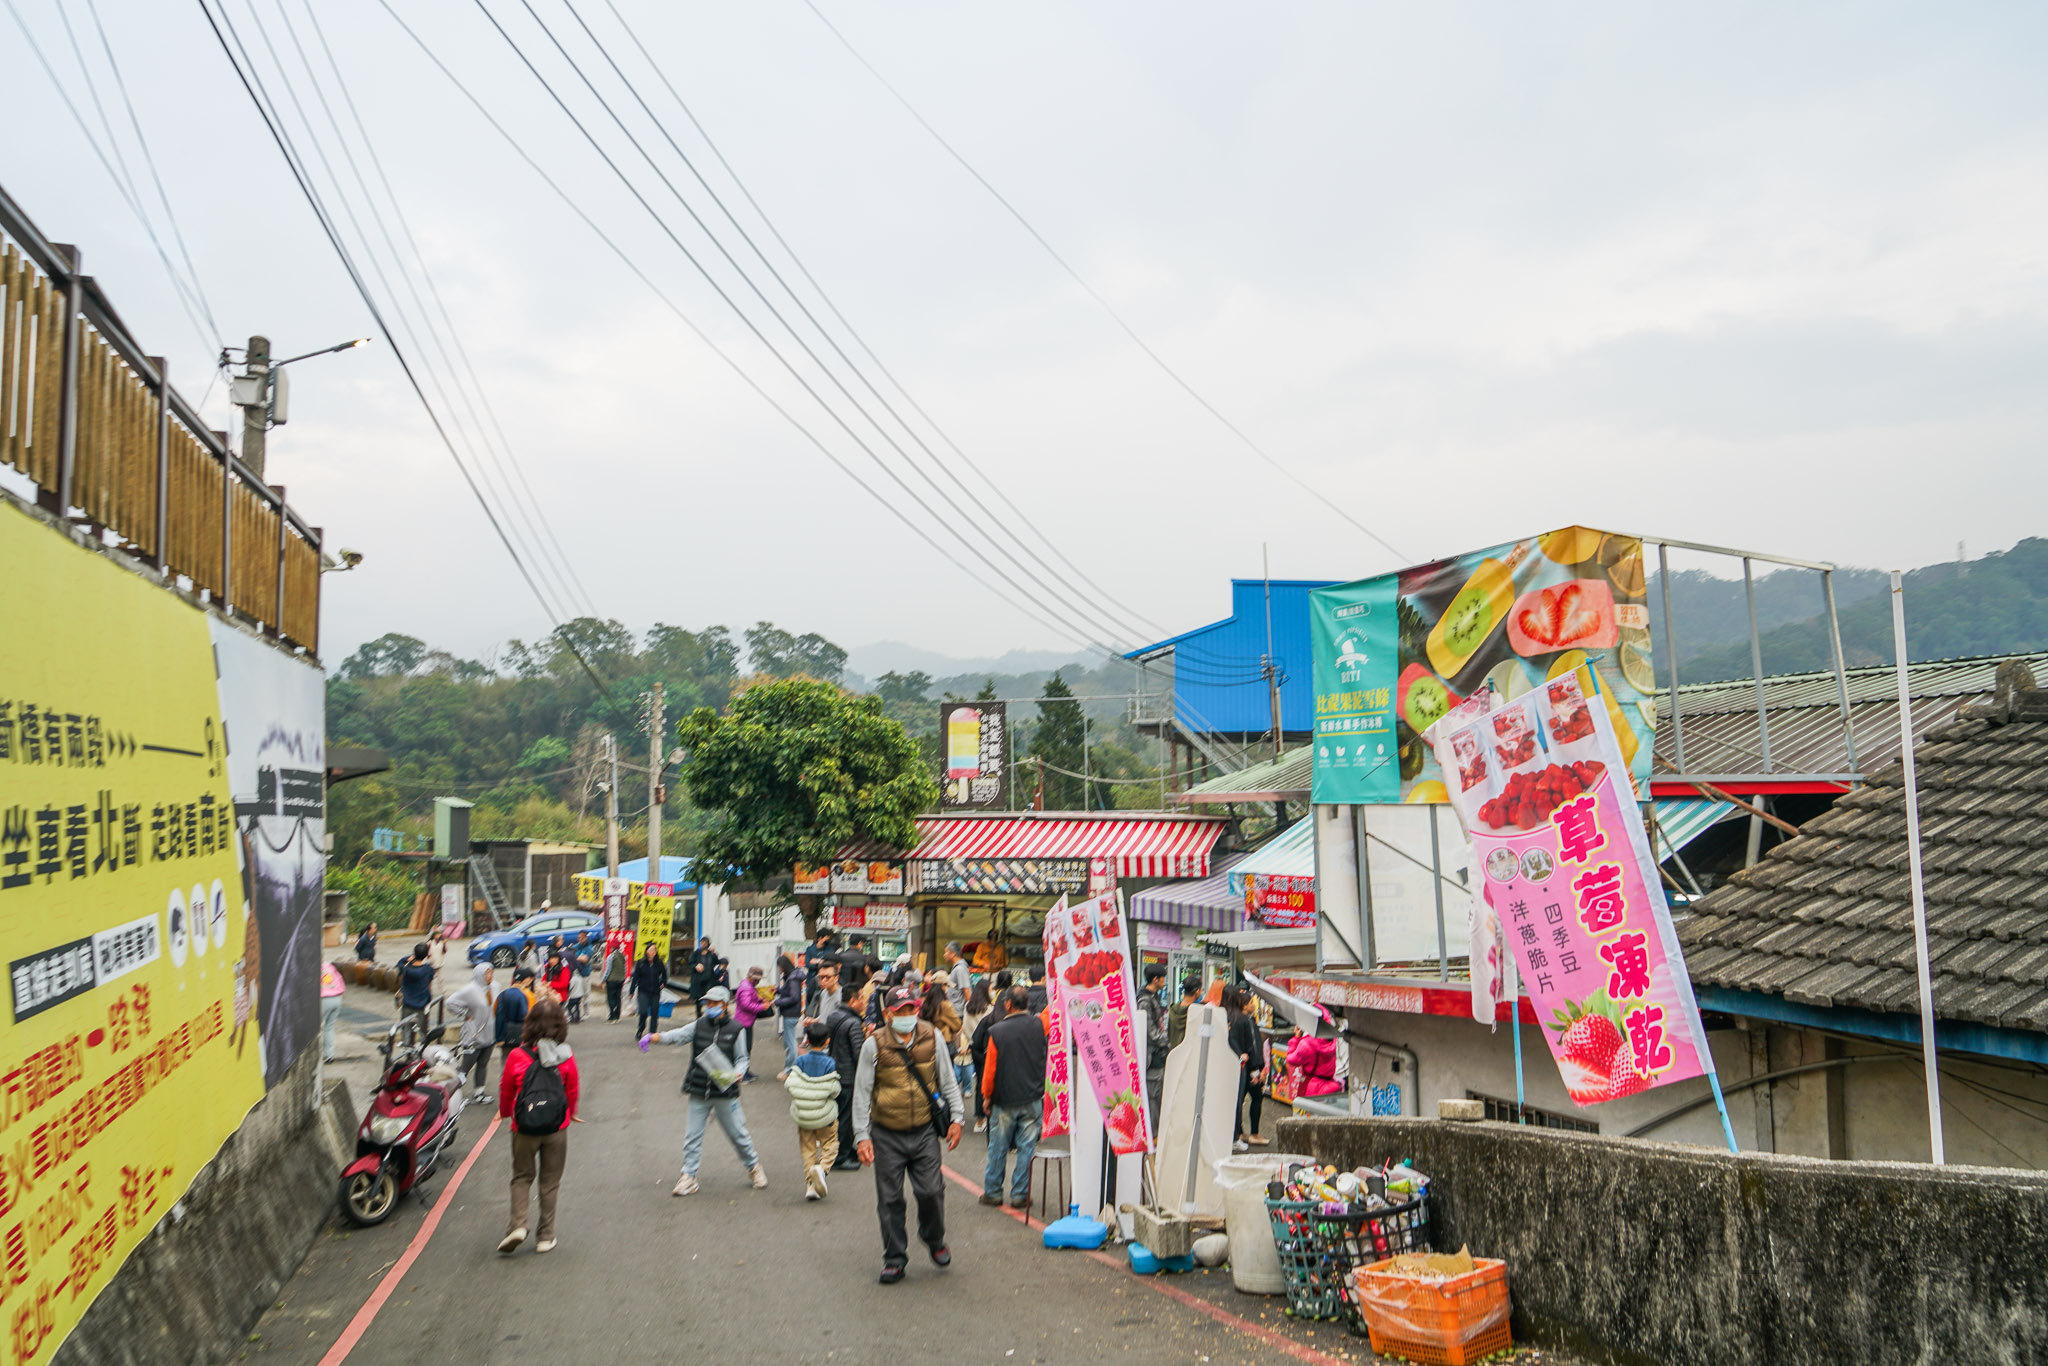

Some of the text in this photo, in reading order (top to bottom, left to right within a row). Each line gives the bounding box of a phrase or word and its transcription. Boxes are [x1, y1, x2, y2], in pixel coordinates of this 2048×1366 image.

[1510, 900, 1555, 994] 洋蔥脆片
[1544, 903, 1581, 974] 四季豆
[1552, 795, 1673, 1077] 草莓凍乾
